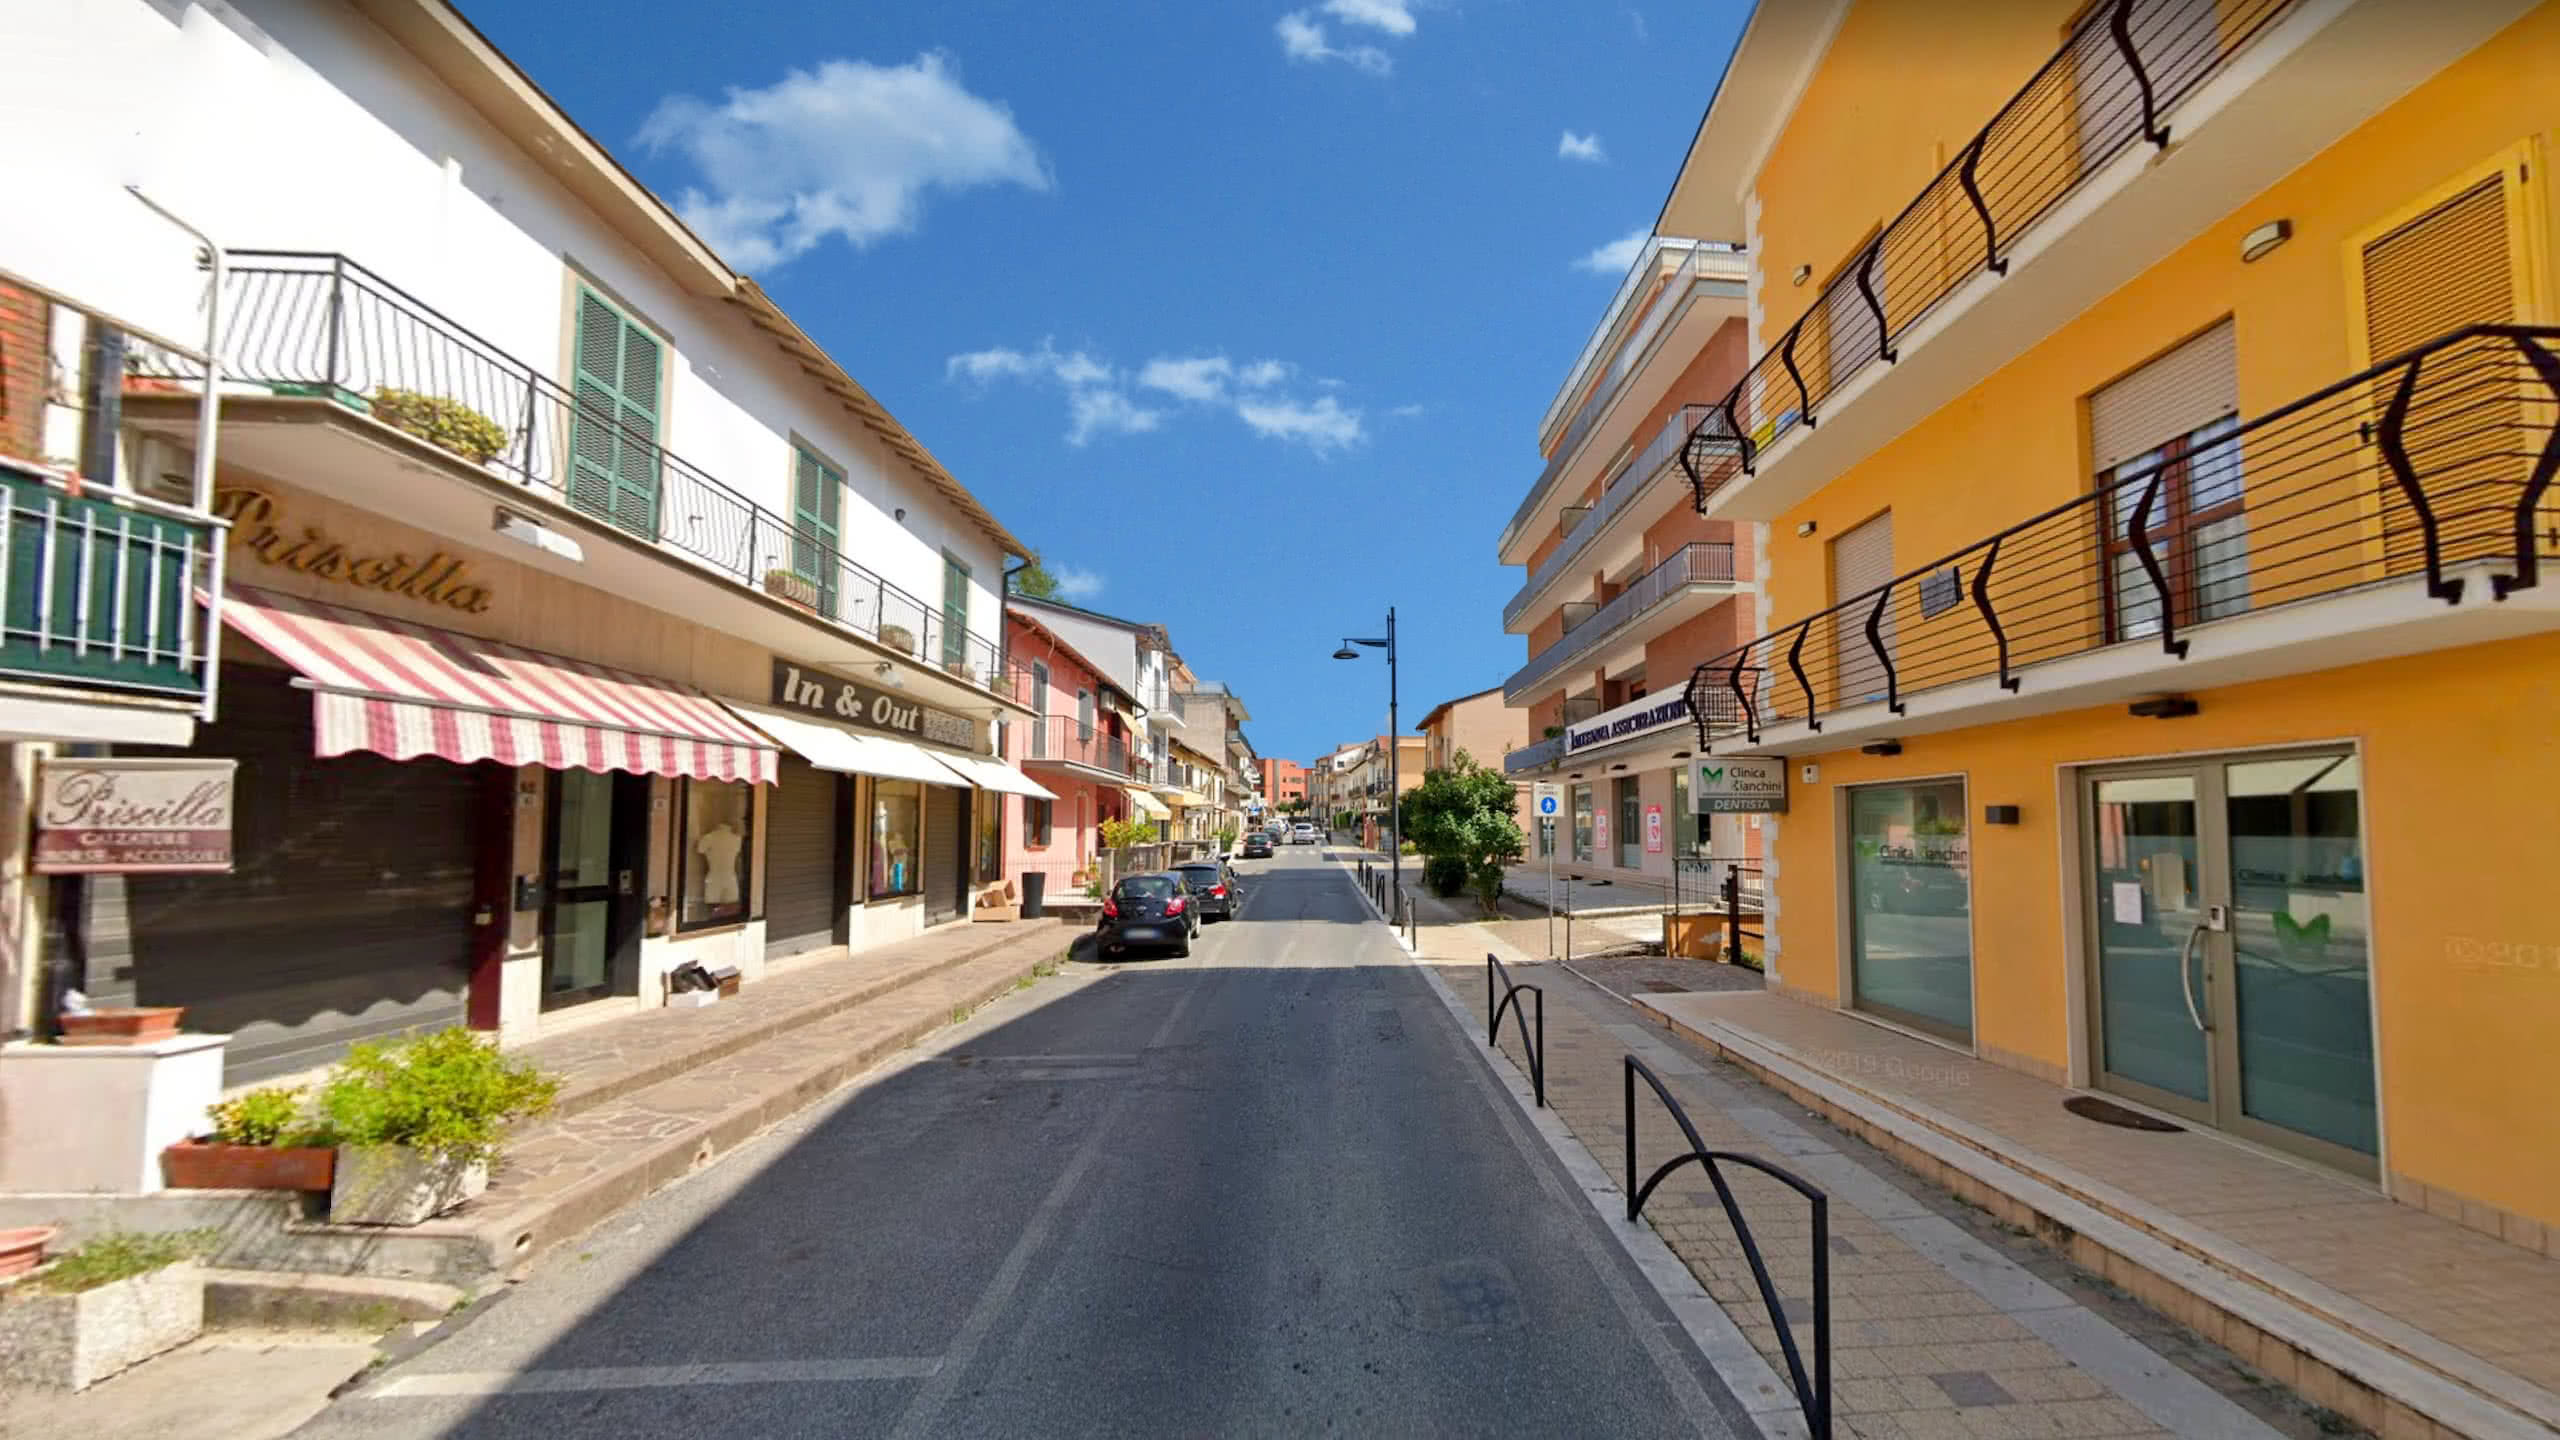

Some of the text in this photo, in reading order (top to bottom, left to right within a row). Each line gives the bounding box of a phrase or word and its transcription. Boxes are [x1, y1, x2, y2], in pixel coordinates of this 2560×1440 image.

[216, 487, 492, 614] Priscilla
[783, 667, 824, 709] In
[835, 684, 863, 718] &
[871, 696, 920, 731] Out
[48, 769, 228, 825] Priscilla
[1730, 767, 1766, 778] Clinica
[1714, 799, 1771, 810] DENTISTA
